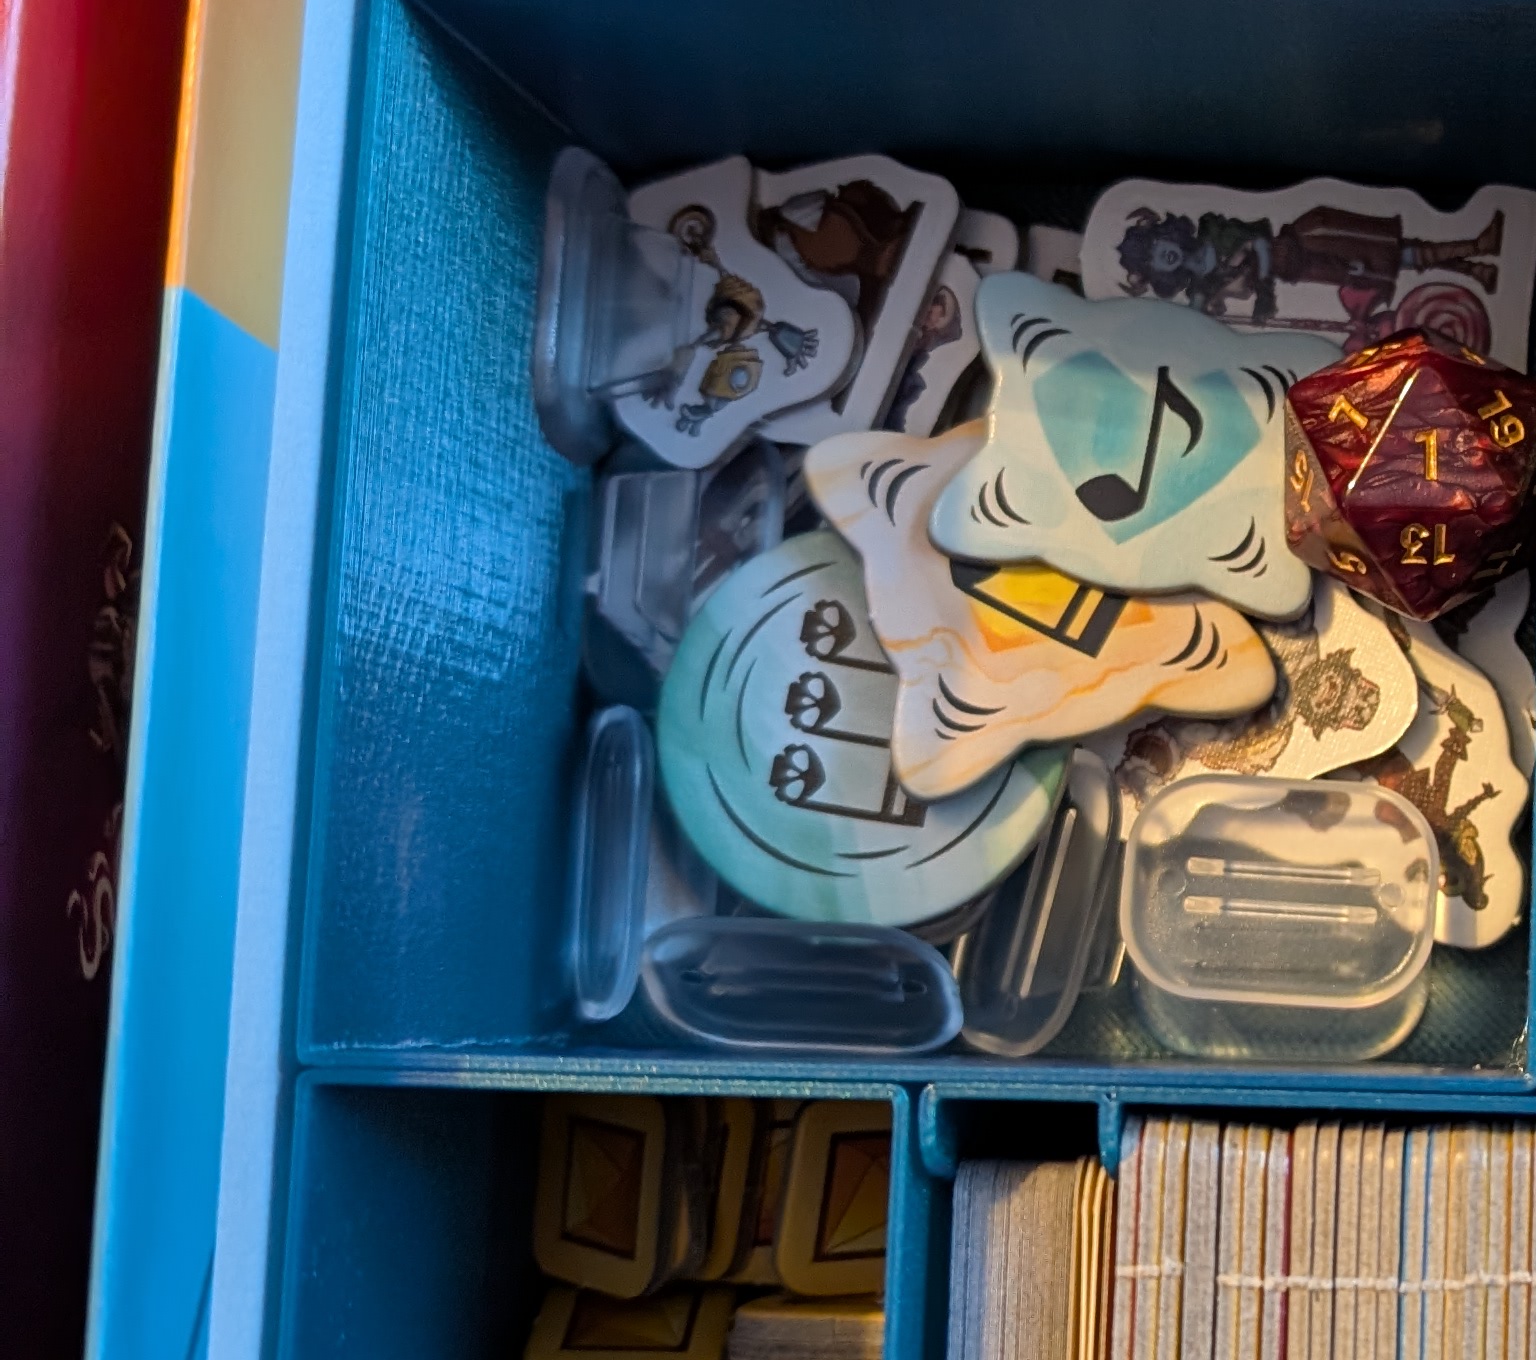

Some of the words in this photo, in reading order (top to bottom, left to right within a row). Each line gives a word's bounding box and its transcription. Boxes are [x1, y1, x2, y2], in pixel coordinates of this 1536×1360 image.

[1477, 389, 1525, 449] 19
[1414, 428, 1438, 482] 1
[1398, 522, 1456, 566] 13
